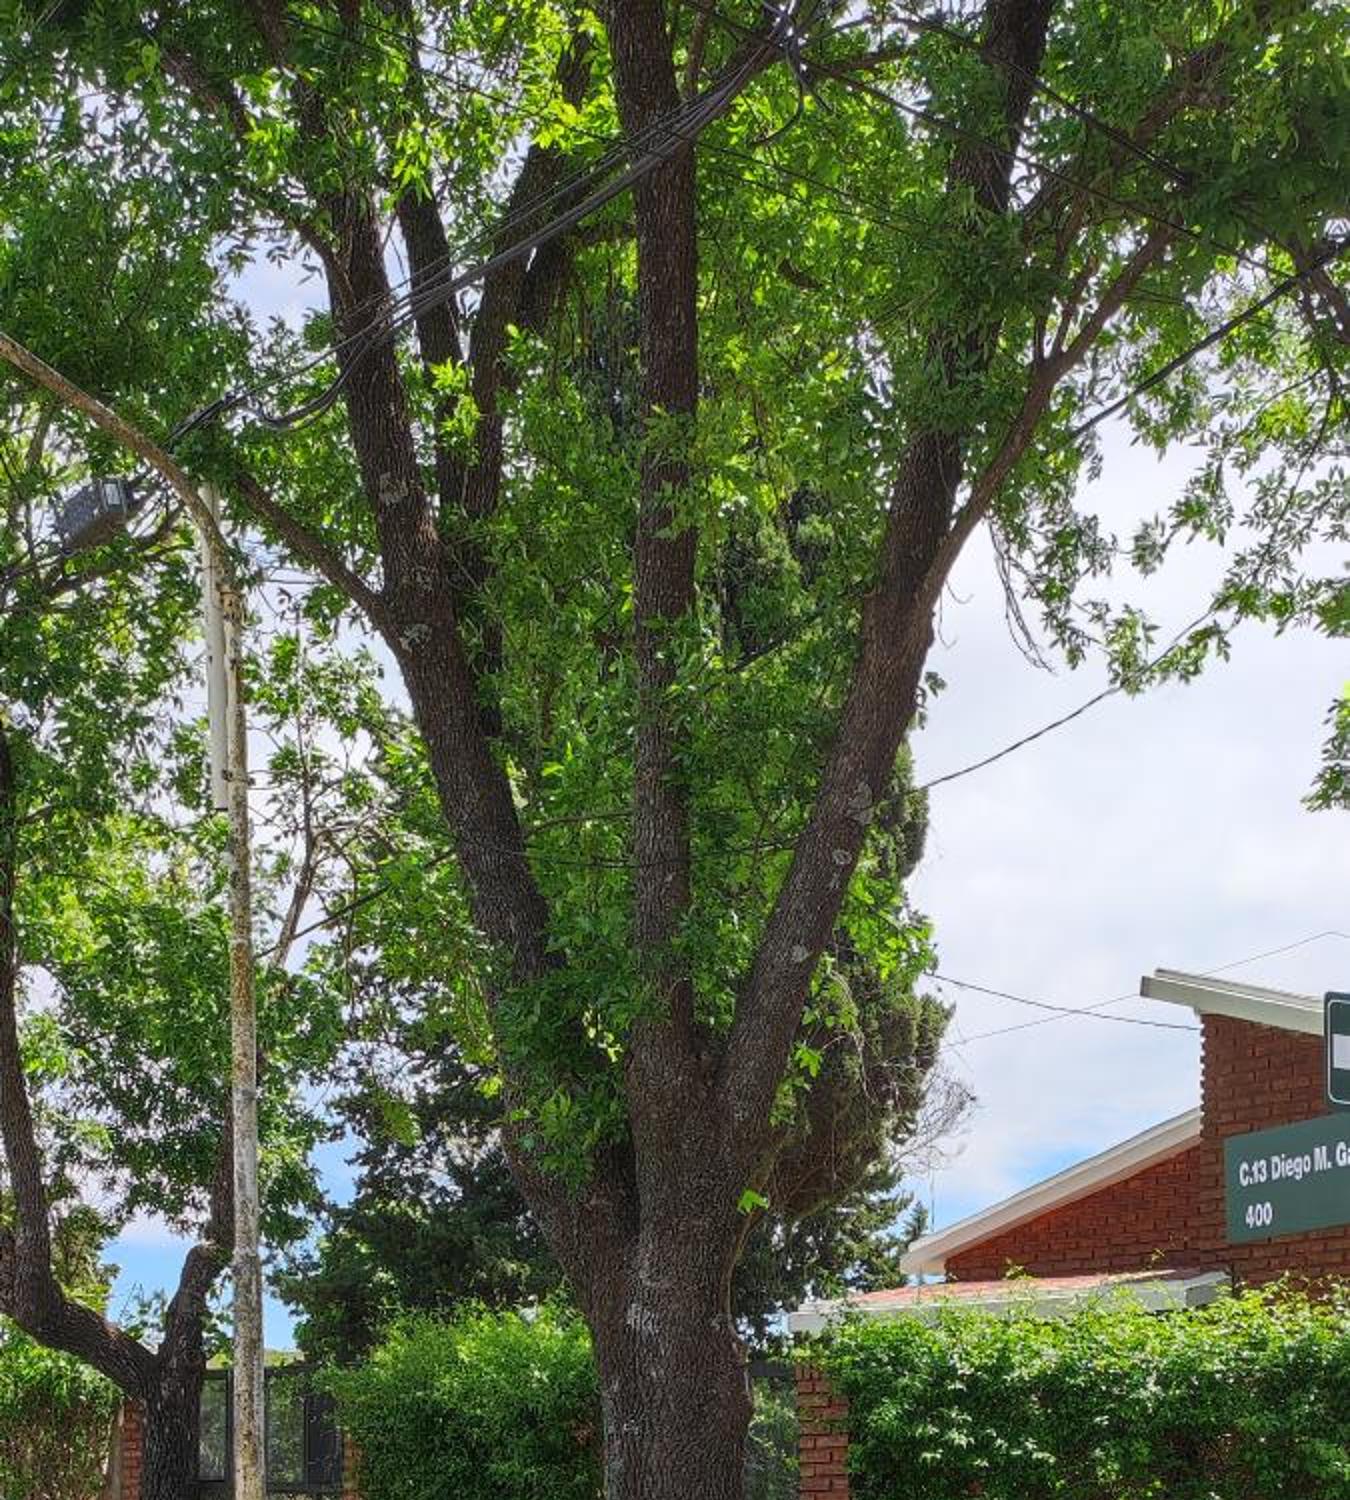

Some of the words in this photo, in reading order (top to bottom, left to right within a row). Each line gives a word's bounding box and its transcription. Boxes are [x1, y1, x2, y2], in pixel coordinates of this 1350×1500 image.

[1239, 1159, 1267, 1187] C.13
[1270, 1153, 1311, 1181] Diego
[1313, 1145, 1332, 1172] M.
[1245, 1201, 1273, 1228] 400
